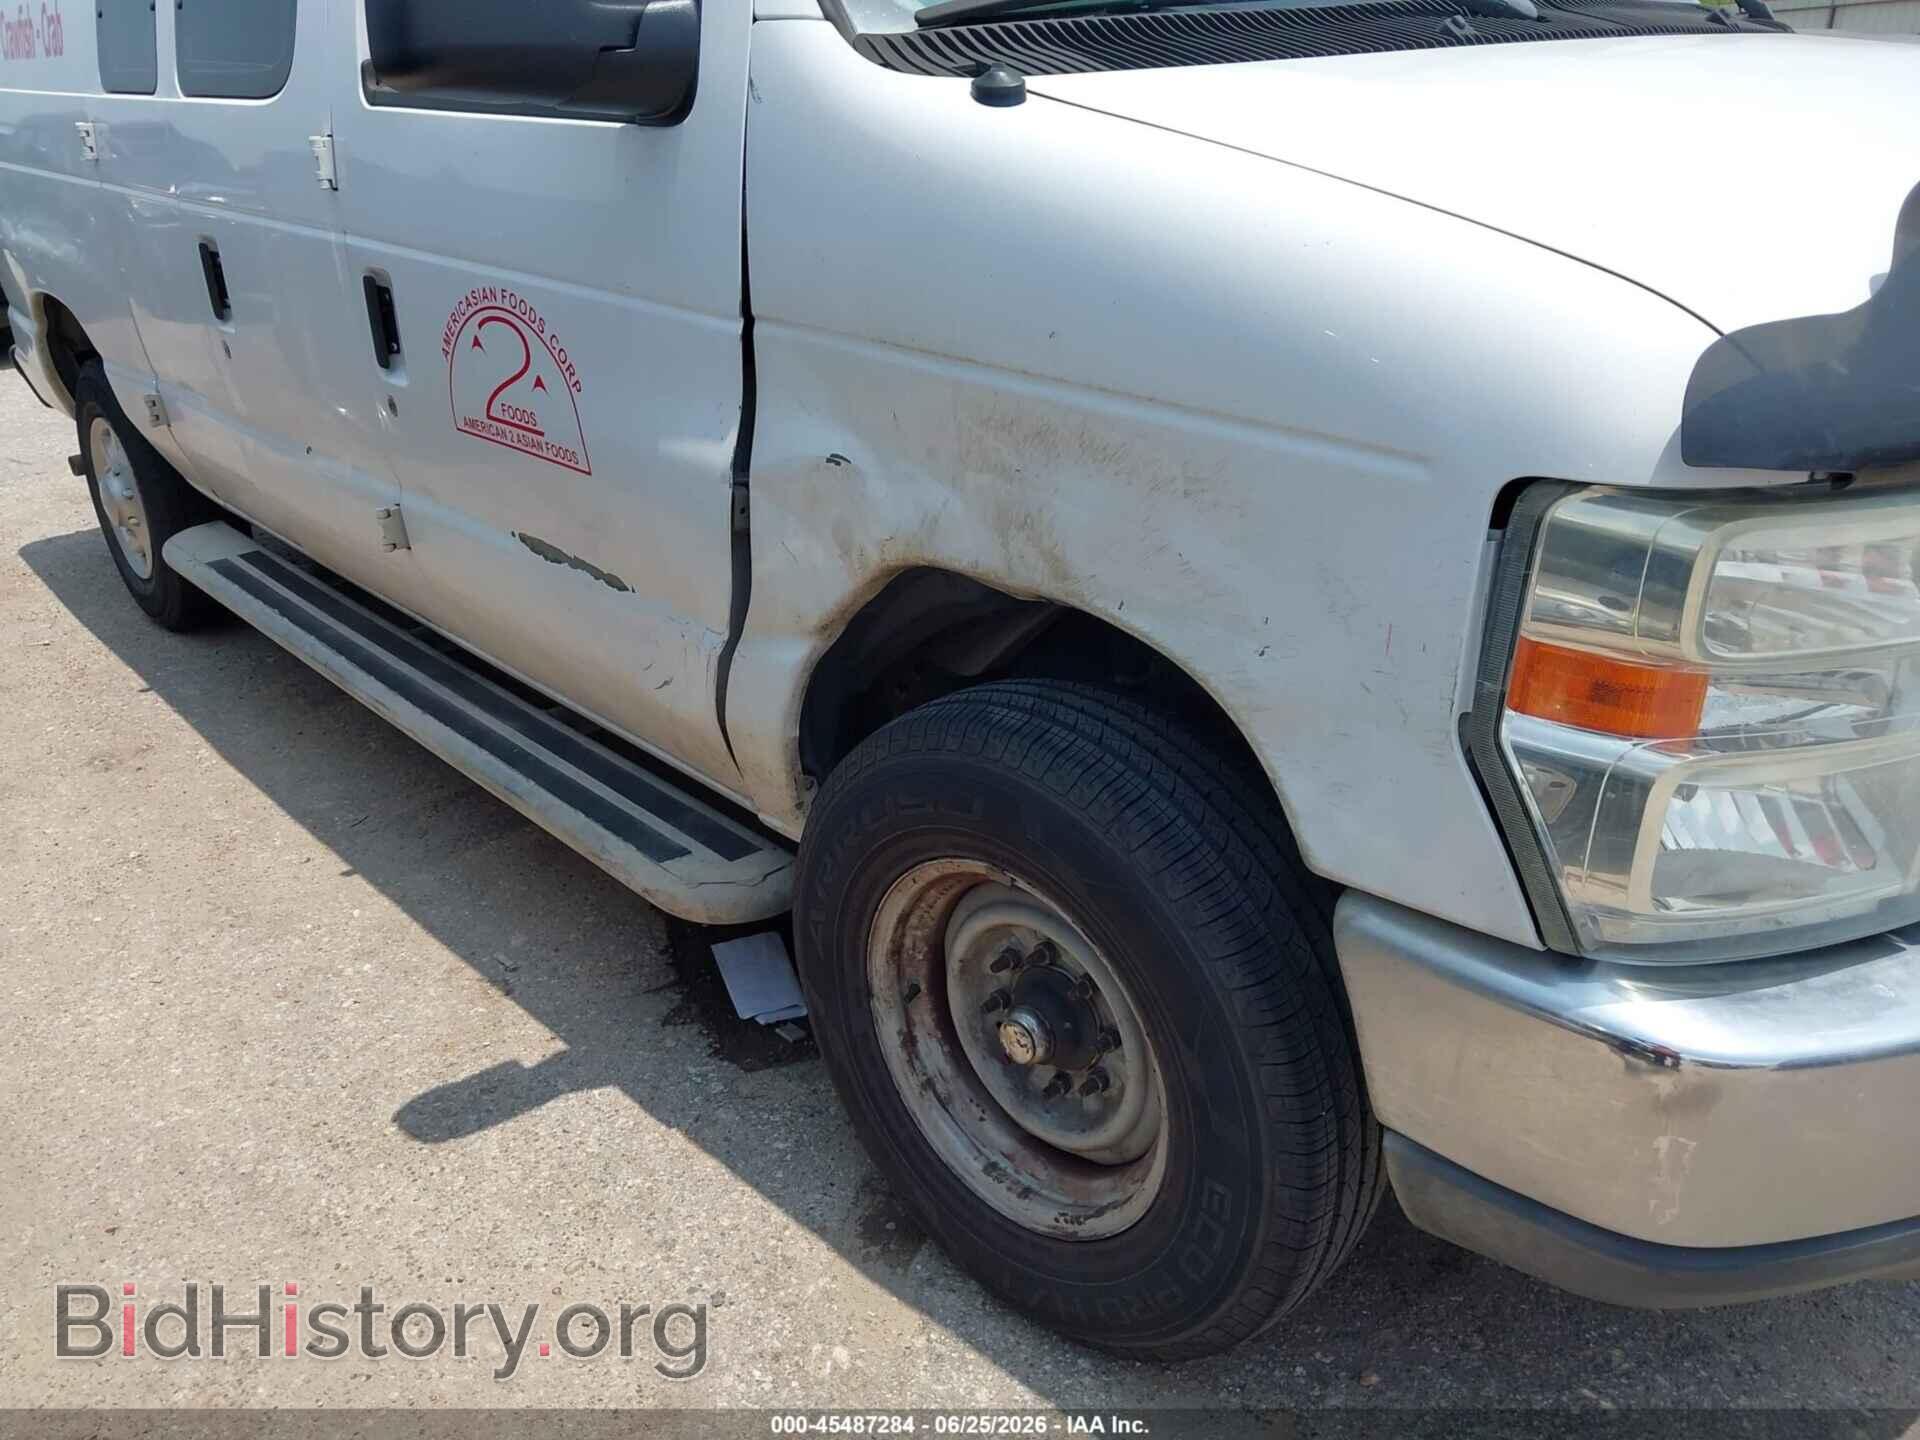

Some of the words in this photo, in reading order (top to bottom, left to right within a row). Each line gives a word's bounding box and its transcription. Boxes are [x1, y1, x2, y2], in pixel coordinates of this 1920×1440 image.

[441, 286, 498, 363] AMERICASIAN
[501, 288, 546, 334] FOODS
[550, 334, 582, 394] CORP
[500, 402, 538, 427] FOODS
[463, 416, 508, 441] AMERICAN
[509, 431, 516, 444] 2
[516, 434, 544, 454] ASIAN
[544, 441, 580, 465] FOODS
